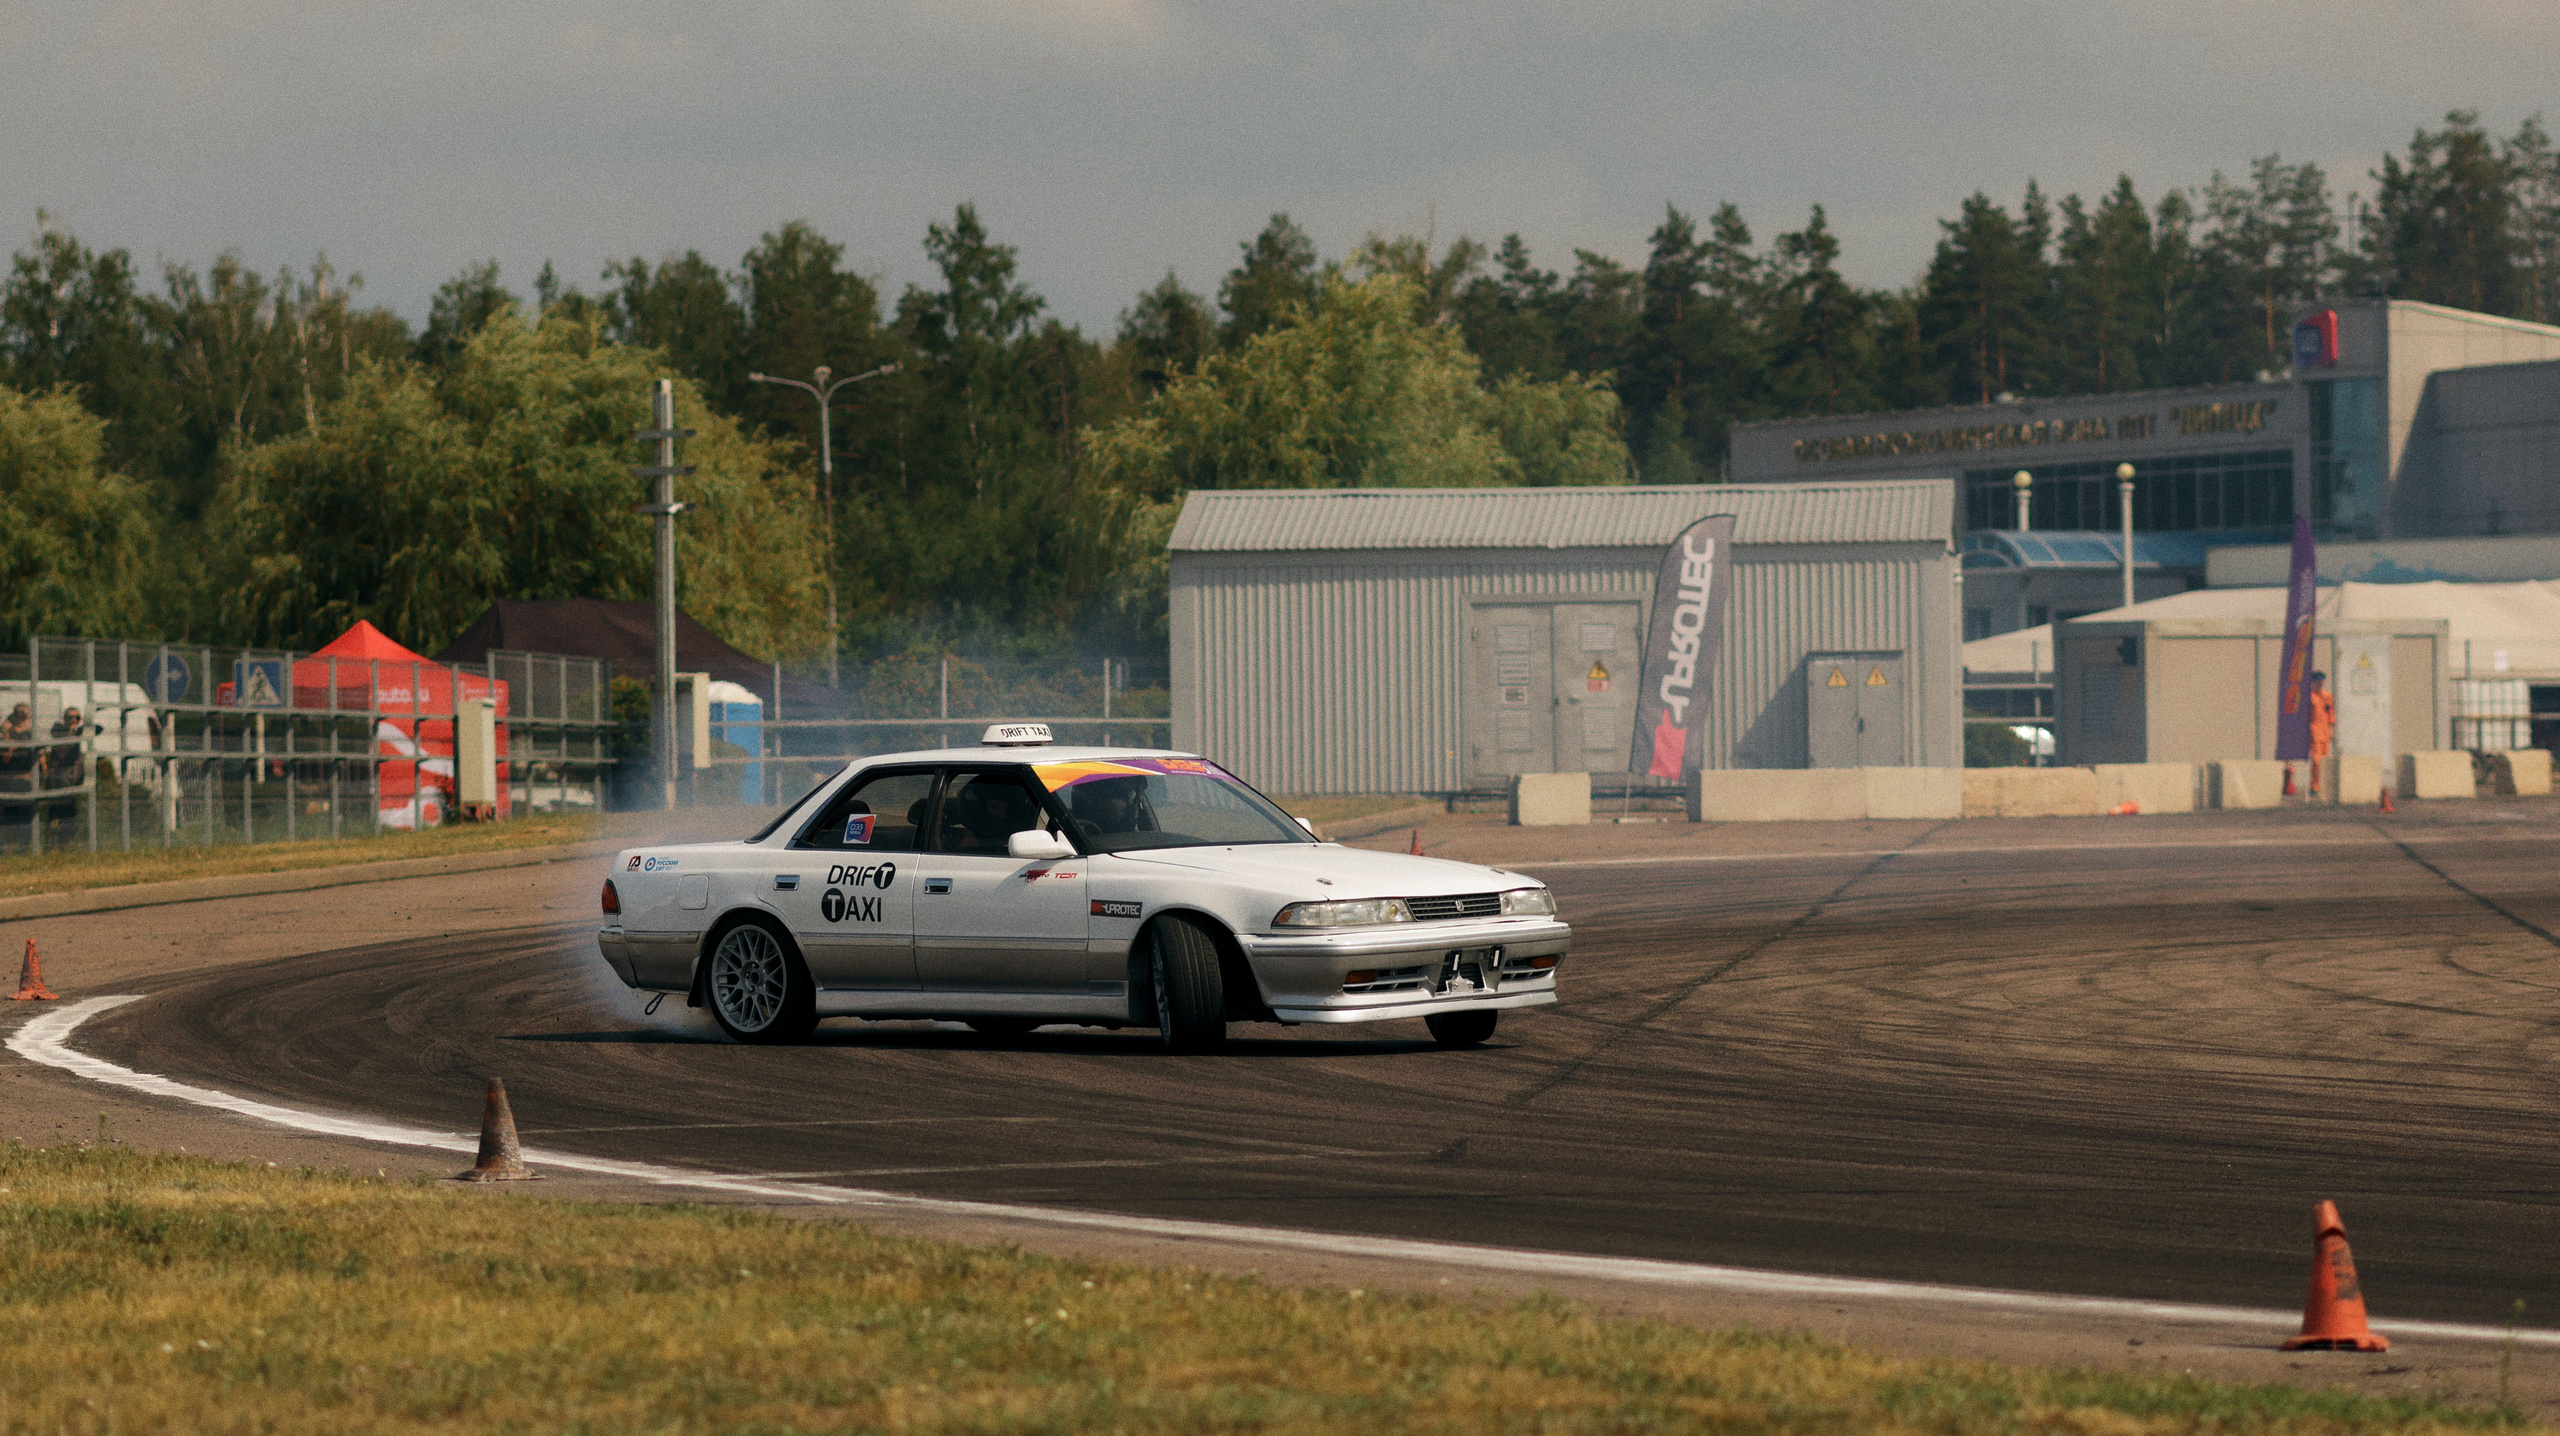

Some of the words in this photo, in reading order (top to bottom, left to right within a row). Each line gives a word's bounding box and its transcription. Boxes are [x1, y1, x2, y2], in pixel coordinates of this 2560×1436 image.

[1000, 725, 1029, 738] DRIFT
[1030, 726, 1052, 737] TAXI
[827, 862, 896, 889] DRIFT
[821, 888, 882, 923] TAXI
